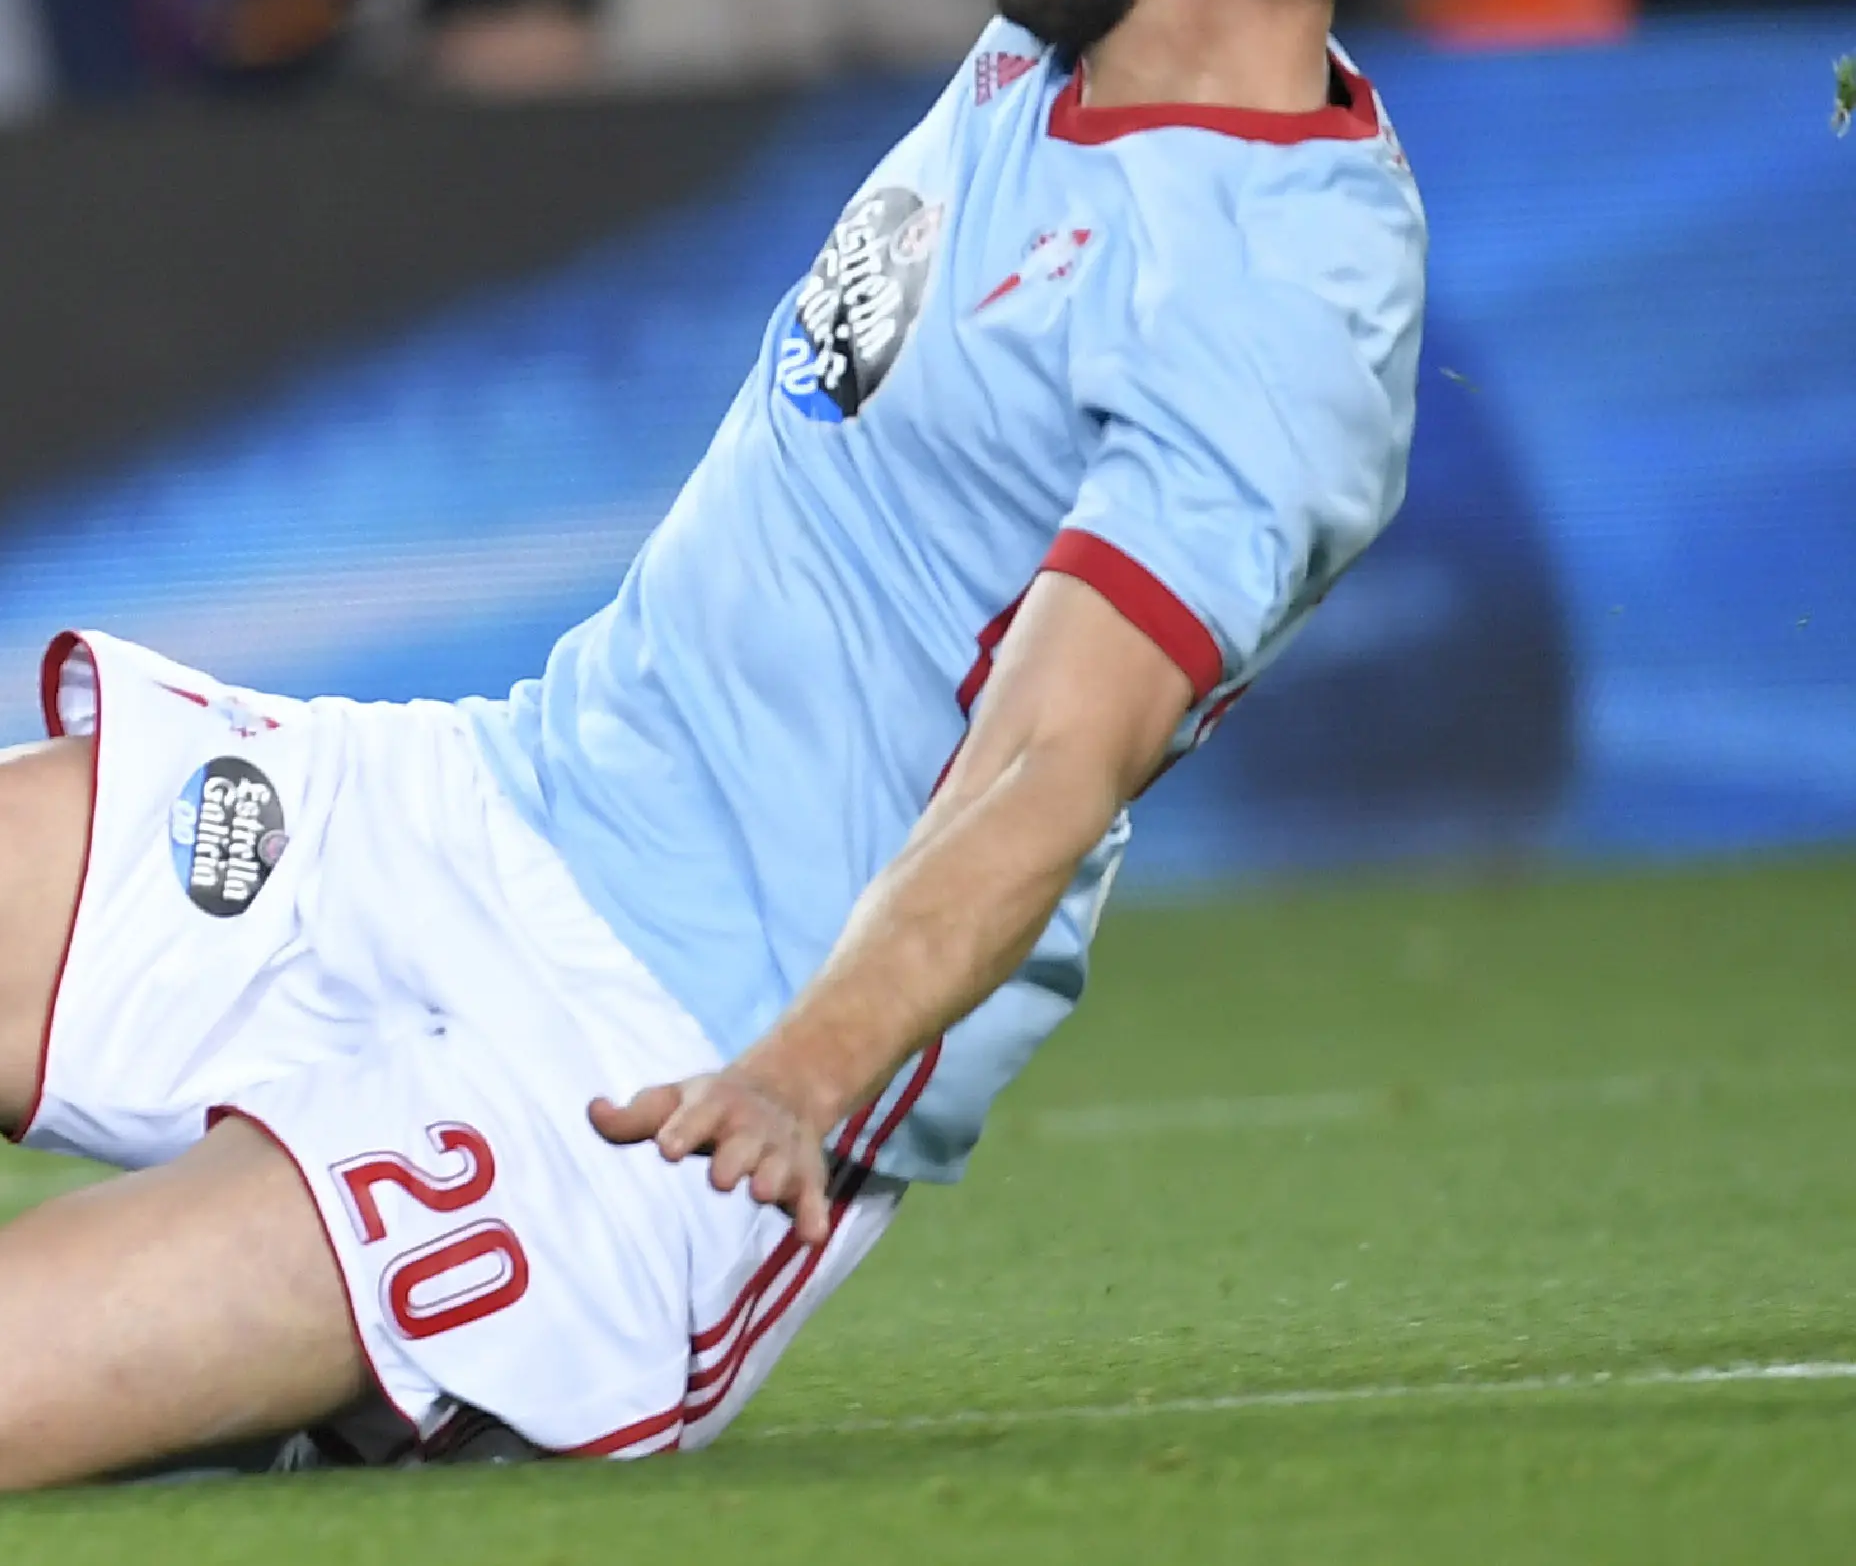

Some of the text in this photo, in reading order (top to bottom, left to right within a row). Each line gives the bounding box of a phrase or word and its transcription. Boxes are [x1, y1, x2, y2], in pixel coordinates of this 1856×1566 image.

[190, 775, 238, 887] Galicia
[221, 776, 272, 902] Estrella
[326, 1119, 530, 1342] 20
